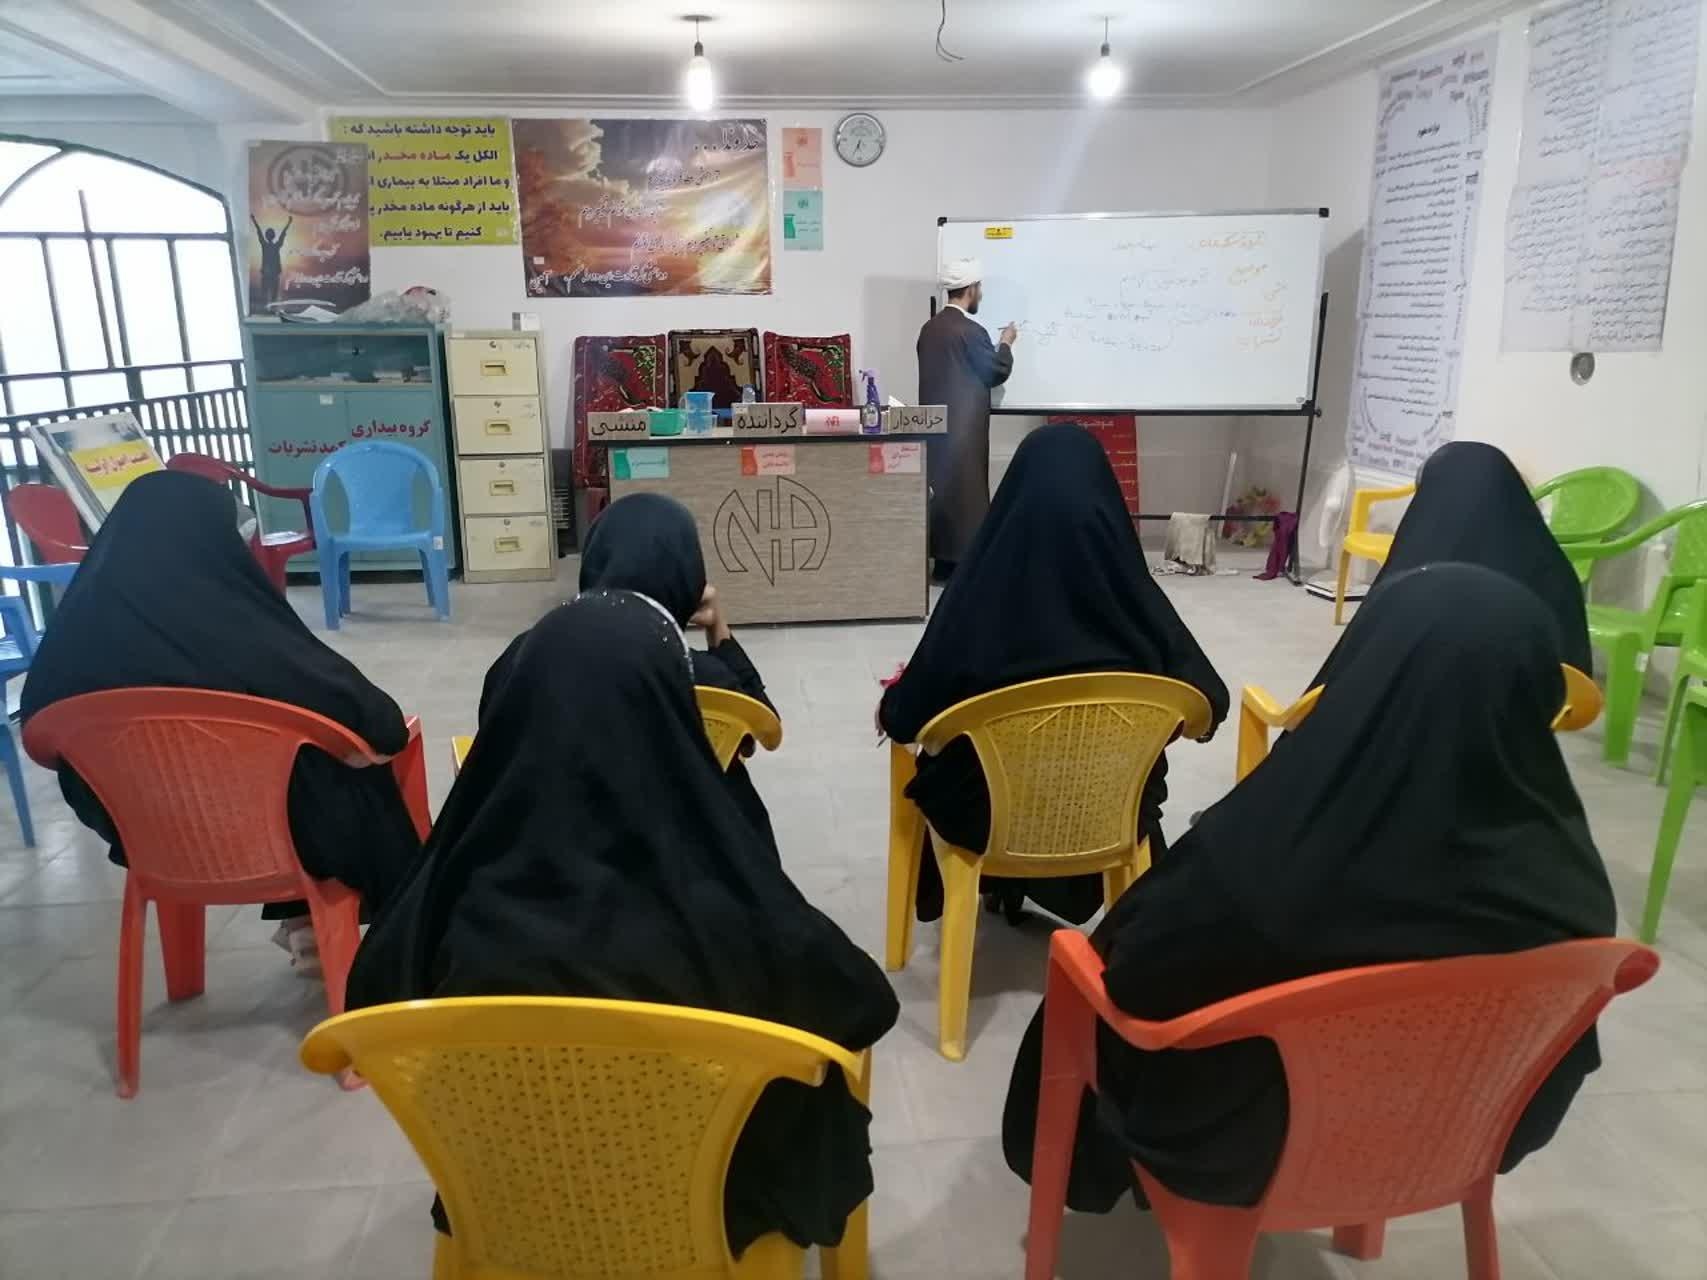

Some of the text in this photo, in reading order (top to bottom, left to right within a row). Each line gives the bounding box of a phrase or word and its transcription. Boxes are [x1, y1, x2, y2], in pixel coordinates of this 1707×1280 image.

[350, 124, 364, 134] که
[367, 124, 403, 138] باشید
[405, 124, 442, 135] داشته
[445, 125, 472, 138] توجه
[474, 124, 496, 138] باید
[454, 151, 472, 164] یک
[473, 150, 498, 163] الکل
[377, 176, 415, 190] بیماری
[418, 177, 430, 189] به
[432, 176, 460, 189] مبتلا
[463, 175, 487, 189] افراد
[490, 175, 504, 186] ما
[377, 200, 407, 215] مخدر
[410, 201, 436, 211] ماده
[438, 199, 475, 214] هرگونه
[477, 201, 486, 214] از
[489, 201, 510, 214] باید
[415, 227, 442, 241] بهبود
[444, 227, 453, 237] تا
[455, 226, 482, 241] کنیم
[737, 405, 800, 434] گرداننده
[351, 419, 398, 439] بیداری
[591, 417, 647, 436] منشی
